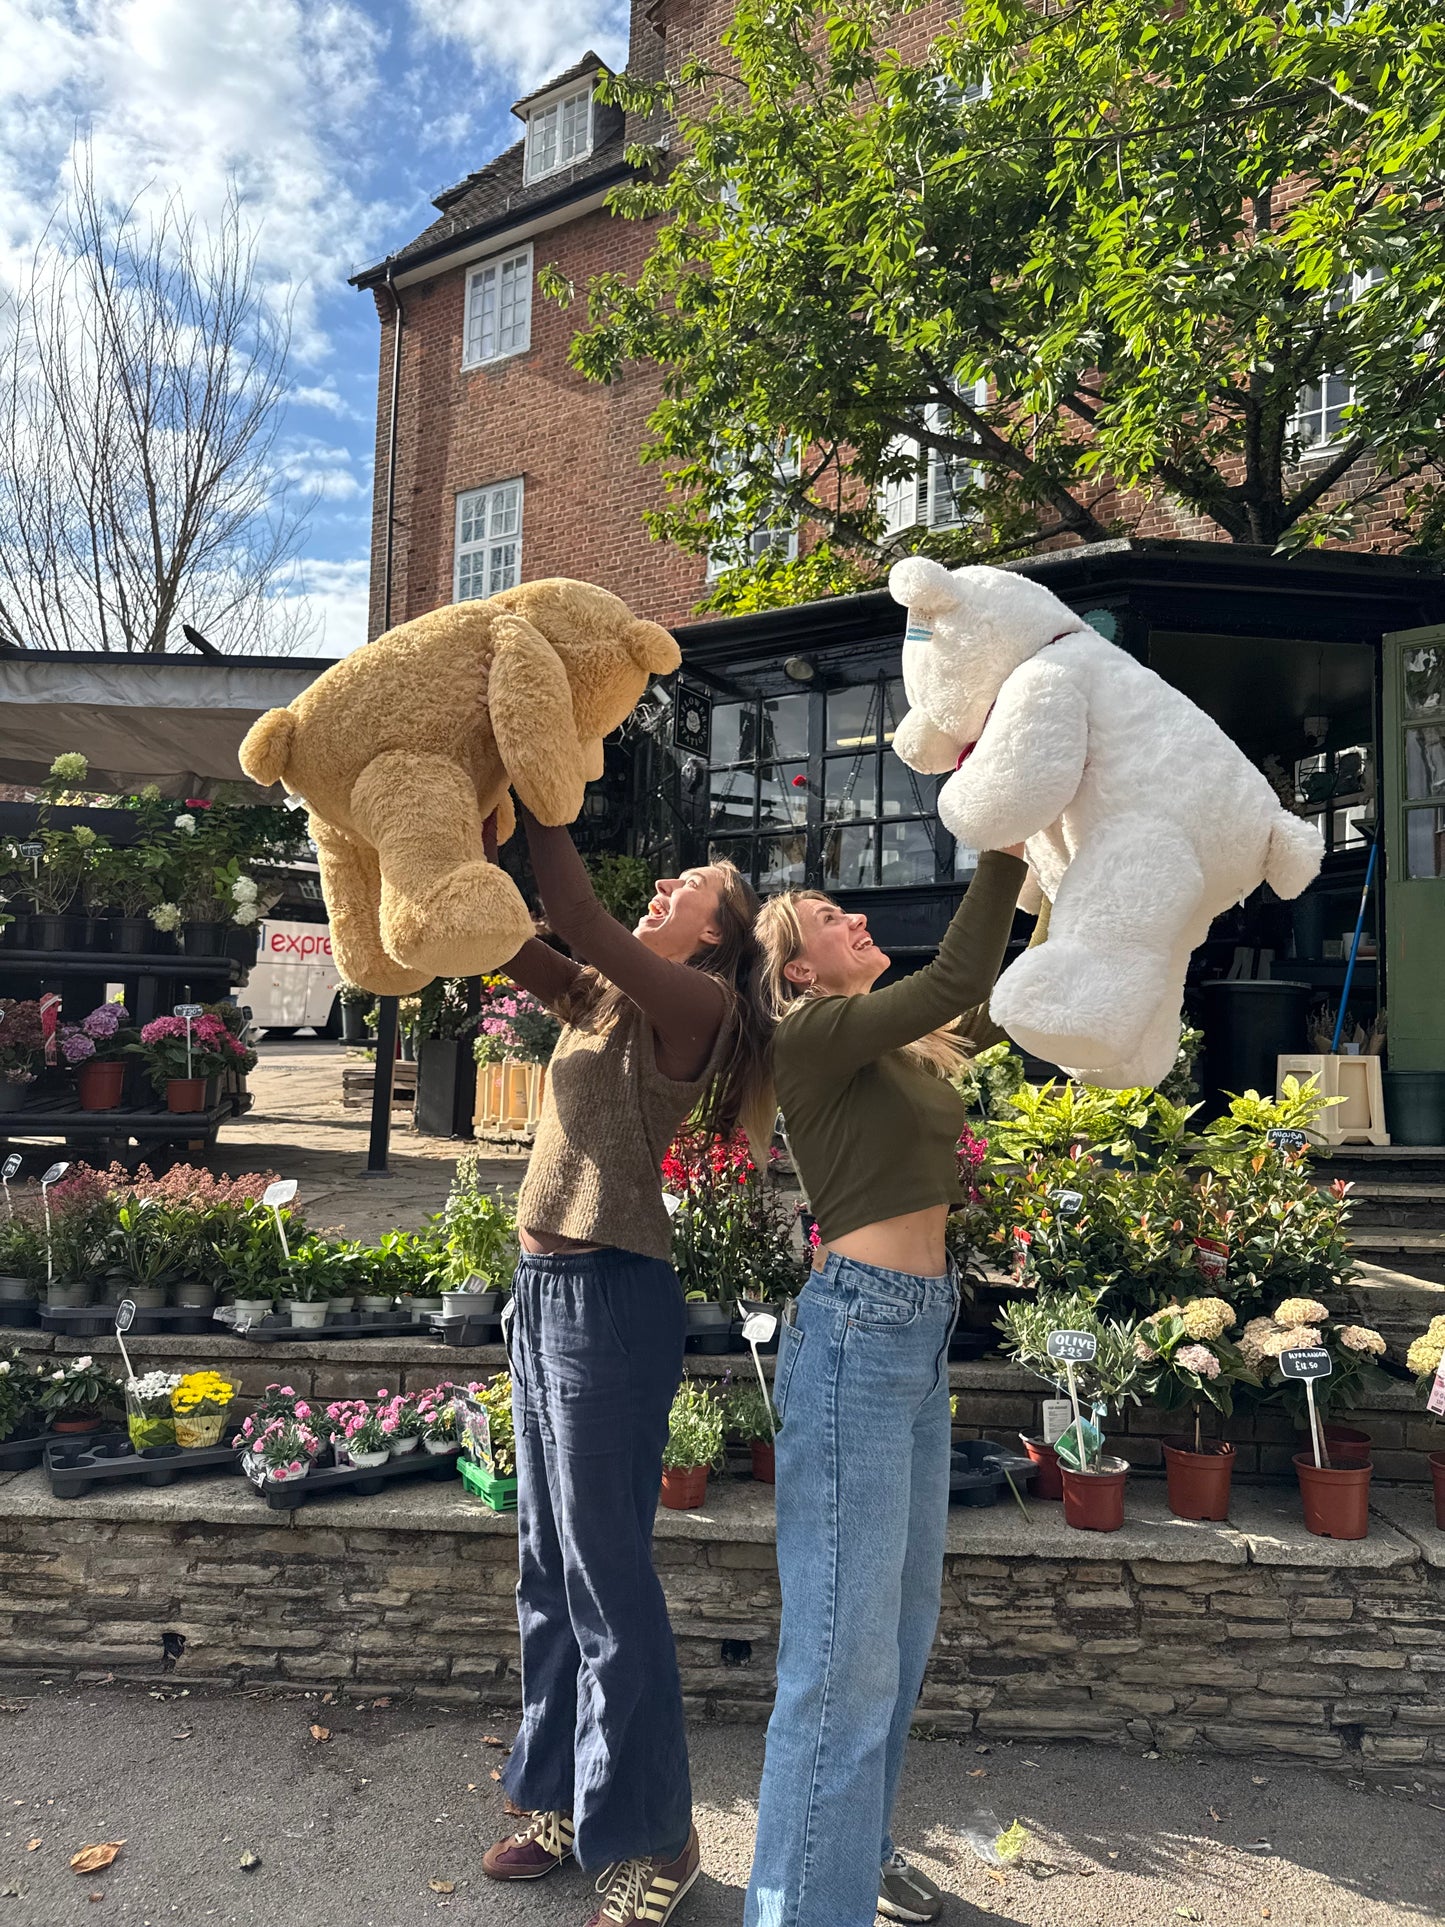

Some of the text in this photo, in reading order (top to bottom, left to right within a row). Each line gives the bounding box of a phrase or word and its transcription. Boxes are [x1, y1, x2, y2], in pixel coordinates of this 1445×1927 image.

[680, 696, 707, 722] FLOWER
[679, 720, 707, 747] STATION
[1055, 1334, 1095, 1350] OLIVE
[1055, 1345, 1083, 1358] £25
